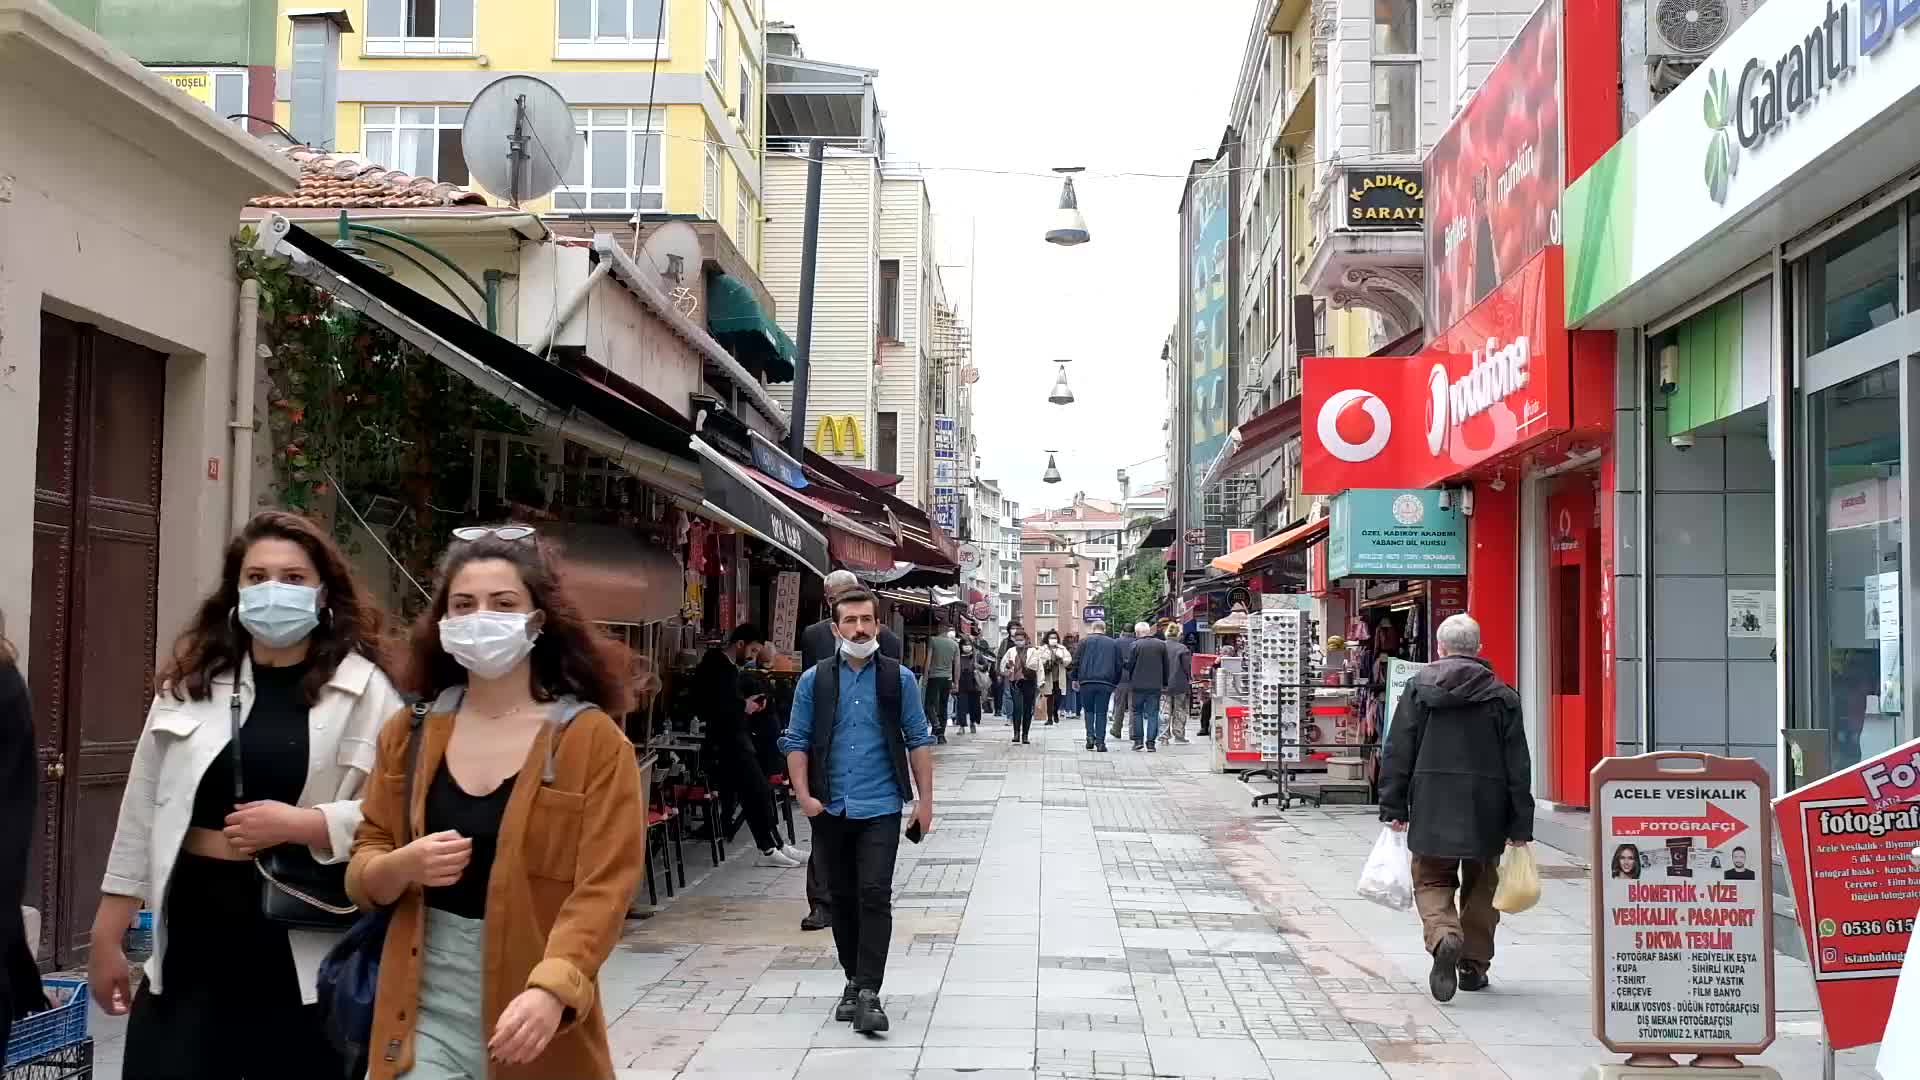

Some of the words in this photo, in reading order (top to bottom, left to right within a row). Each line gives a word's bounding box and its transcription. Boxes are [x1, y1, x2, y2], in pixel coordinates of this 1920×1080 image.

[1737, 0, 1848, 148] Garanti
[1352, 207, 1424, 219] SARAYI
[1449, 335, 1530, 427] vodafone
[1614, 789, 1661, 799] ACELE
[1666, 787, 1747, 799] VESİKALIK
[1640, 820, 1736, 833] FOTOĞRAFÇI
[1628, 880, 1697, 903] BİOMETRİK
[1707, 880, 1738, 903] VİZE
[1612, 904, 1678, 926] VESİKALIK
[1688, 907, 1756, 927] PASAPORT
[1842, 920, 1882, 936] 0536
[1885, 918, 1914, 933] 615
[1635, 931, 1643, 949] 5
[1685, 928, 1733, 949] TESLİM
[1616, 951, 1657, 962] FOTOĞRAF
[1658, 952, 1682, 962] BASKI
[1736, 953, 1757, 964] EŞYA
[1616, 964, 1637, 973] KUPA
[1723, 965, 1745, 974] KUPA
[1692, 976, 1714, 985] KALP
[1715, 977, 1745, 986] YASTIK
[1616, 987, 1652, 998] ÇERÇEVE
[1692, 988, 1712, 997] FİLM
[1713, 988, 1741, 998] BANYO
[1641, 1002, 1671, 1012] VOSVOS
[1677, 1001, 1704, 1012] DÜĞÜN
[1705, 1002, 1760, 1015] FOTOĞRAFÇISI
[1637, 1015, 1650, 1027] DIŞ
[1651, 1015, 1678, 1026] MEKAN
[1679, 1015, 1733, 1027] FOTOĞRAFÇISI
[1638, 1028, 1684, 1039] STÜDYOMUZ
